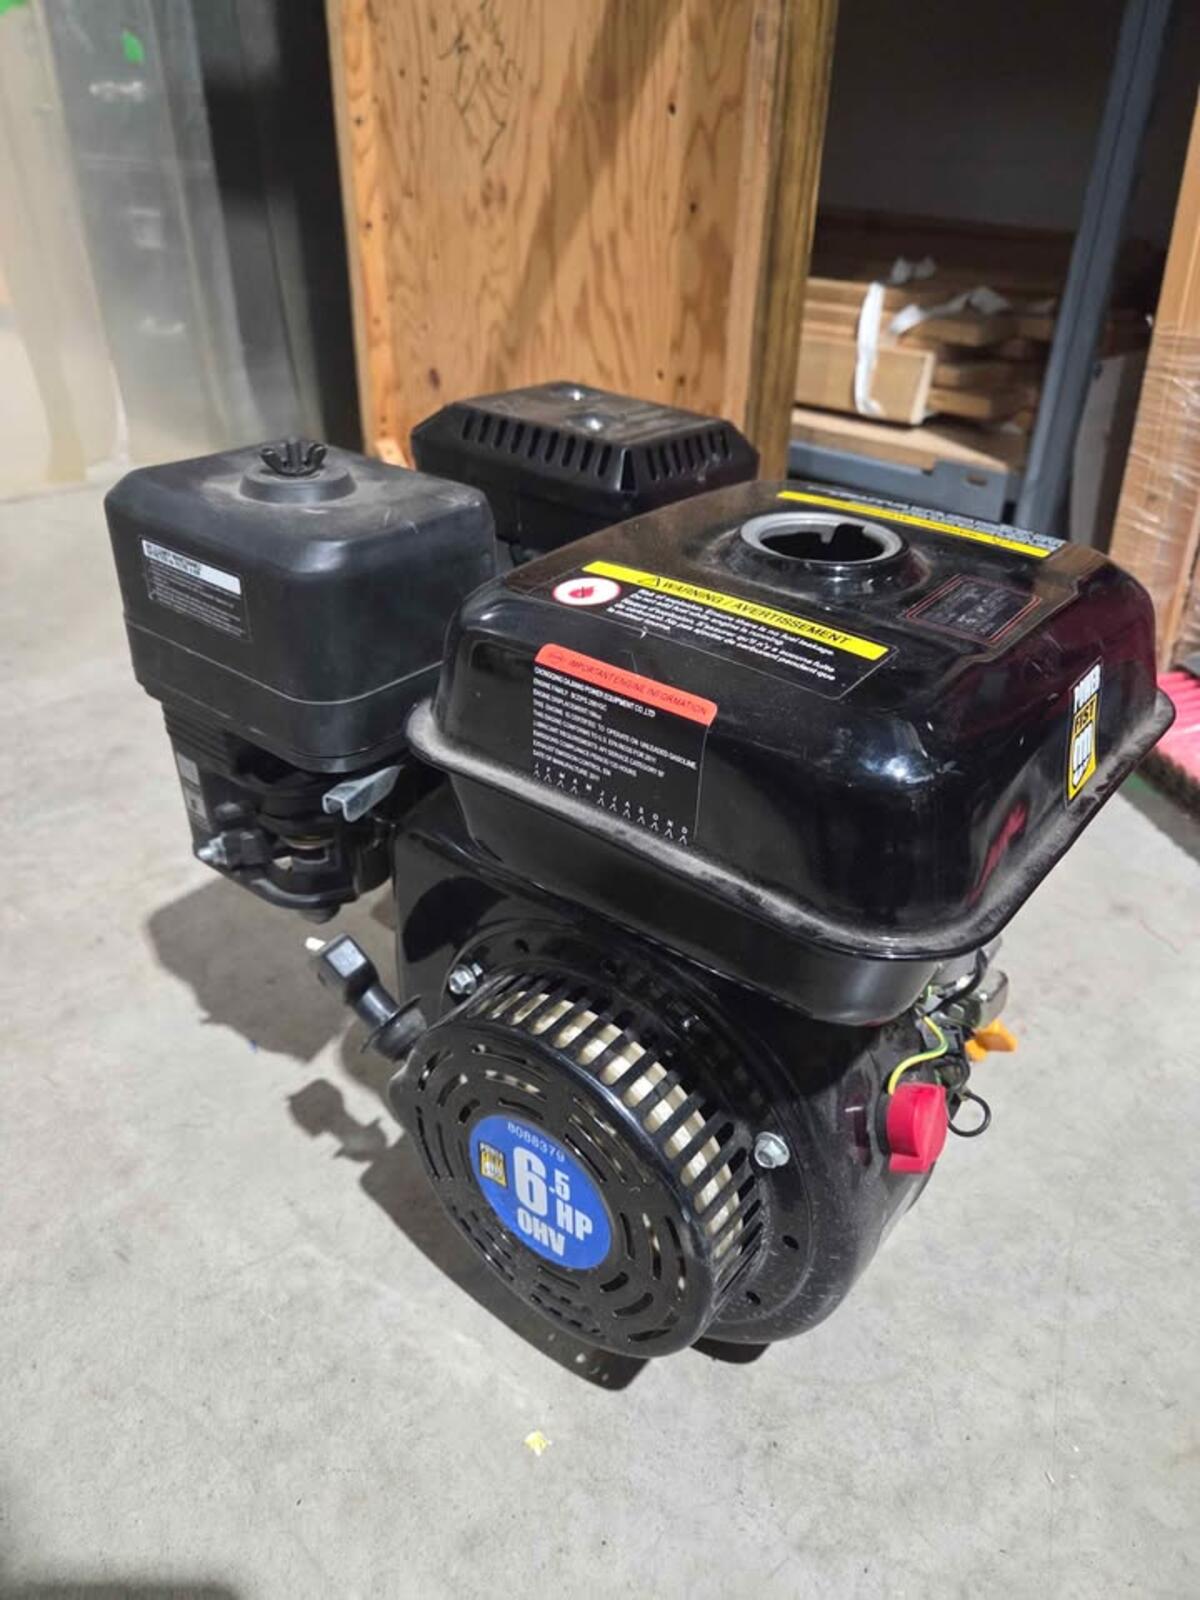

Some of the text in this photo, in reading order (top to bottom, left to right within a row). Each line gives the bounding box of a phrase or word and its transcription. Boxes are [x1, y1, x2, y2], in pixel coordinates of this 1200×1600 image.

[664, 582, 725, 604] WARNING
[735, 601, 849, 644] AVERTISSEMENT
[570, 659, 611, 680] IMPORTANT
[648, 688, 706, 715] INFORMATION
[507, 1122, 565, 1162] 8088379
[518, 1207, 566, 1257] OHV
[557, 1198, 592, 1241] HP
